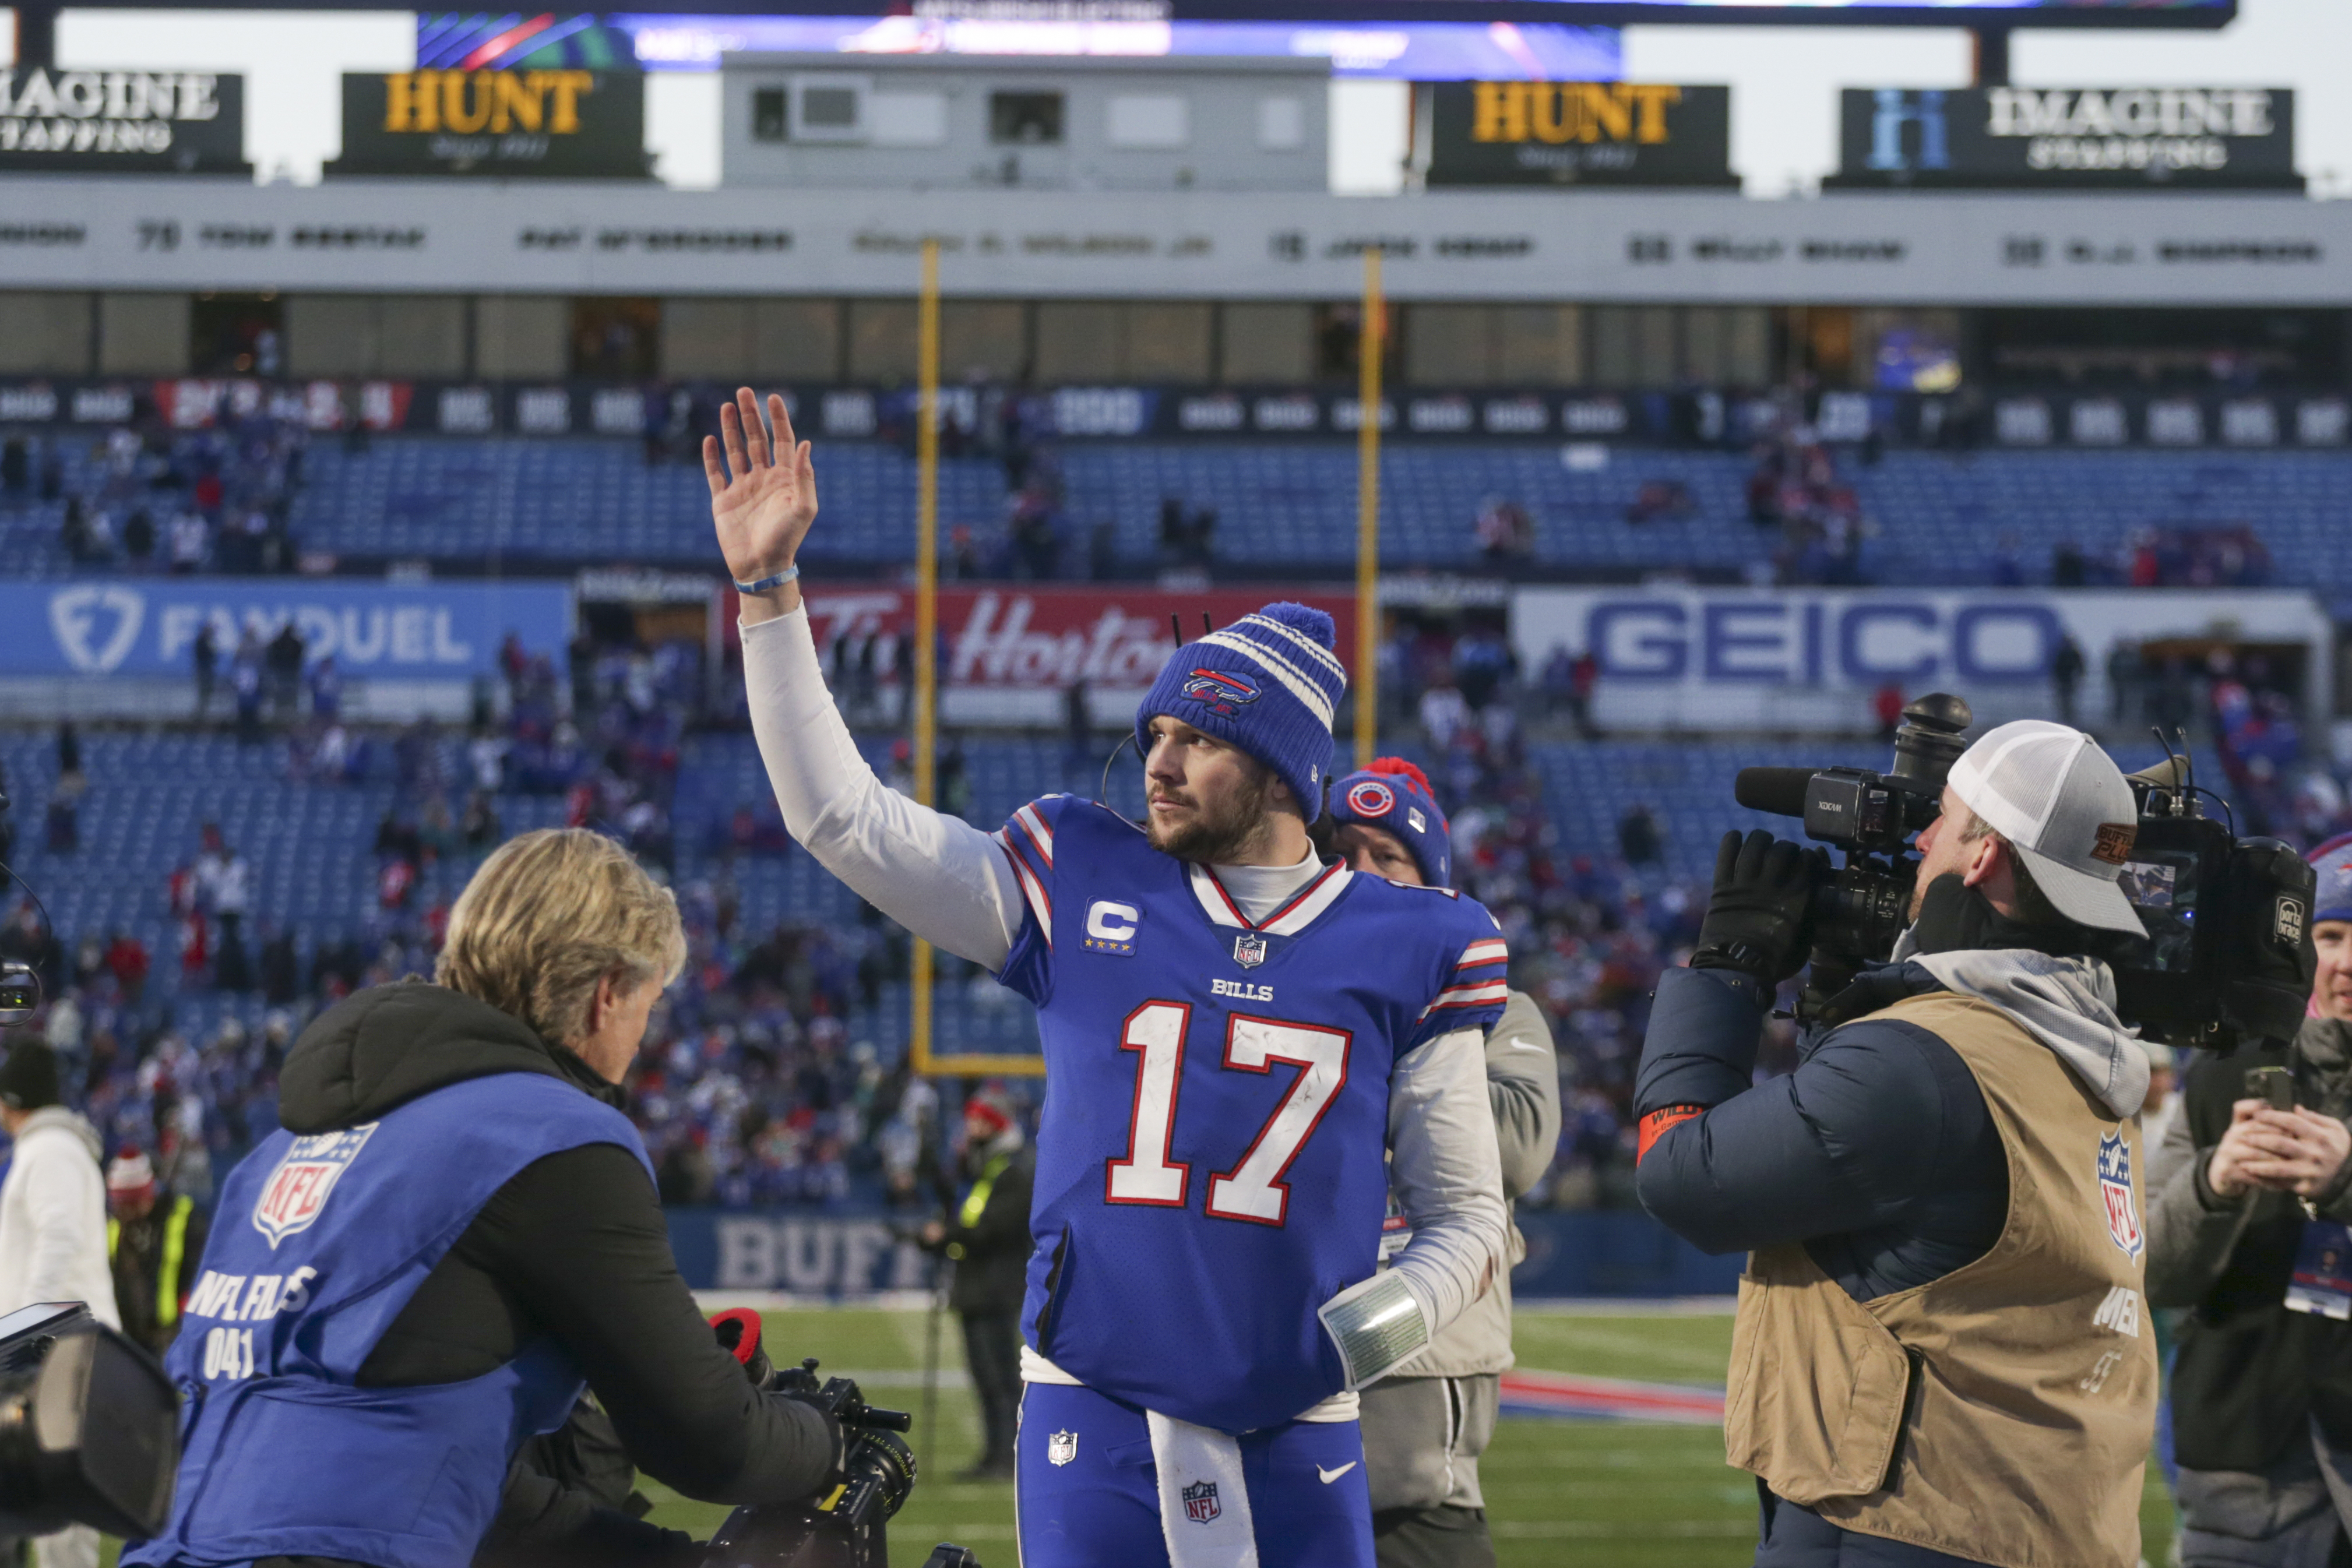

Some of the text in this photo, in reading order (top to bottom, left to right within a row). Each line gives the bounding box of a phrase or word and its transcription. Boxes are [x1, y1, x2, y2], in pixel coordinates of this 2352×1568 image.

[383, 69, 594, 135] HUNT
[1471, 80, 1682, 144] HUNT
[1985, 87, 2274, 136] IMAGINE
[1588, 602, 2061, 681] GEICO
[1818, 801, 1843, 813] XDCAM
[1087, 901, 1139, 942] C
[1239, 947, 1260, 963] NFL
[1211, 978, 1274, 1002] BILLS
[1104, 998, 1354, 1227] 17
[263, 1166, 331, 1224] NFL
[2103, 1183, 2138, 1248] NFL
[185, 1264, 318, 1322] NFL FILS
[204, 1326, 255, 1380] 041
[1051, 1444, 1072, 1460] NFL
[1186, 1497, 1218, 1520] NFL
